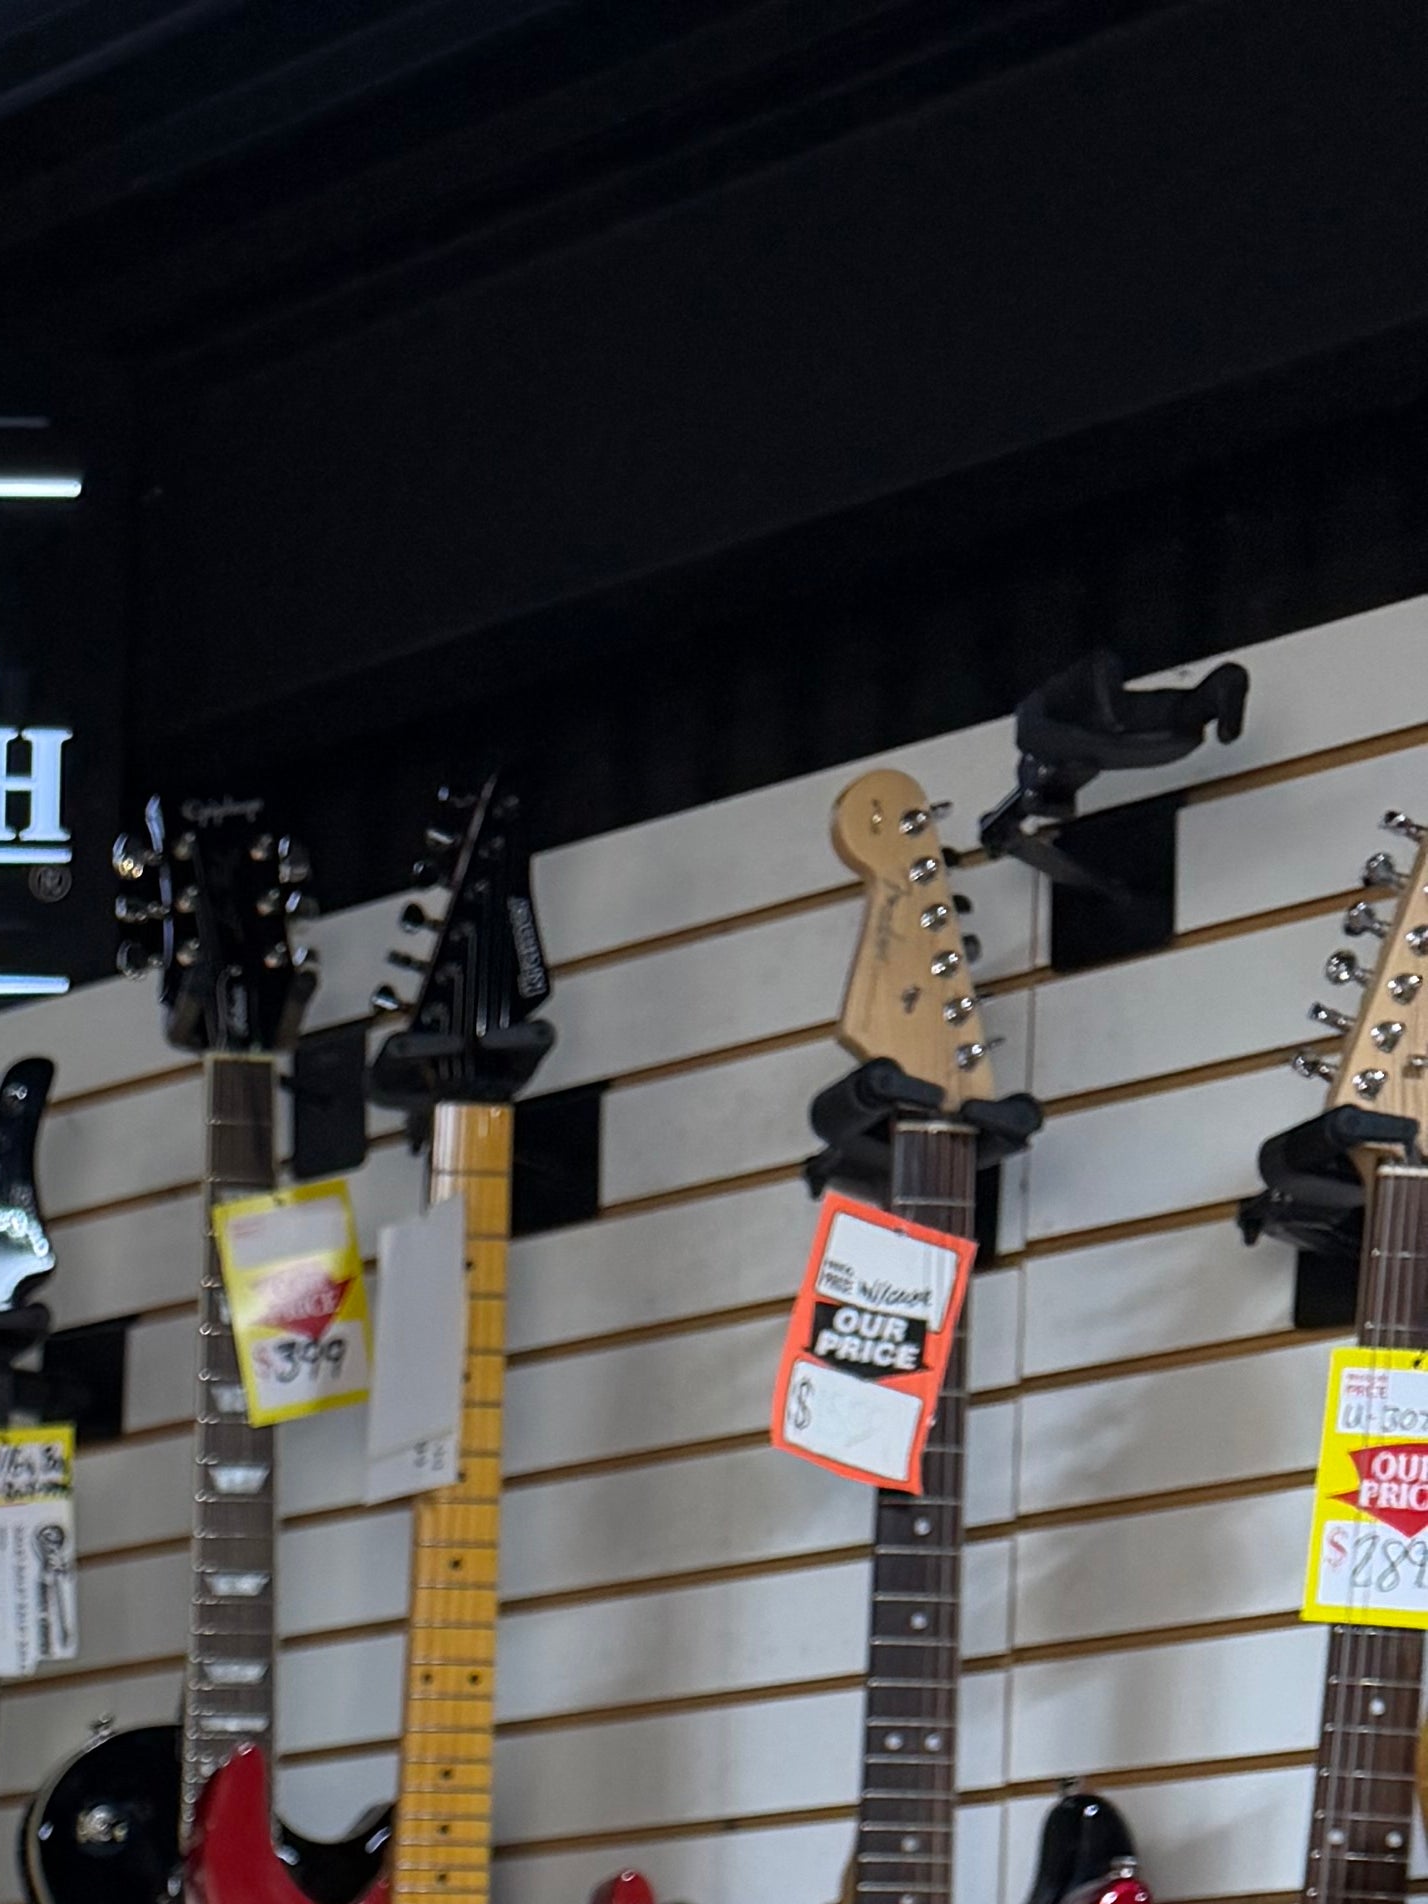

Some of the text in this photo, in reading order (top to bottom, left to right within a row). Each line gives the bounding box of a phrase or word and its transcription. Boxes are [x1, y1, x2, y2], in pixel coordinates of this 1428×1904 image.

[832, 1307, 909, 1342] OUR
[815, 1330, 923, 1371] PRICE
[1357, 1478, 1428, 1512] PRIC
